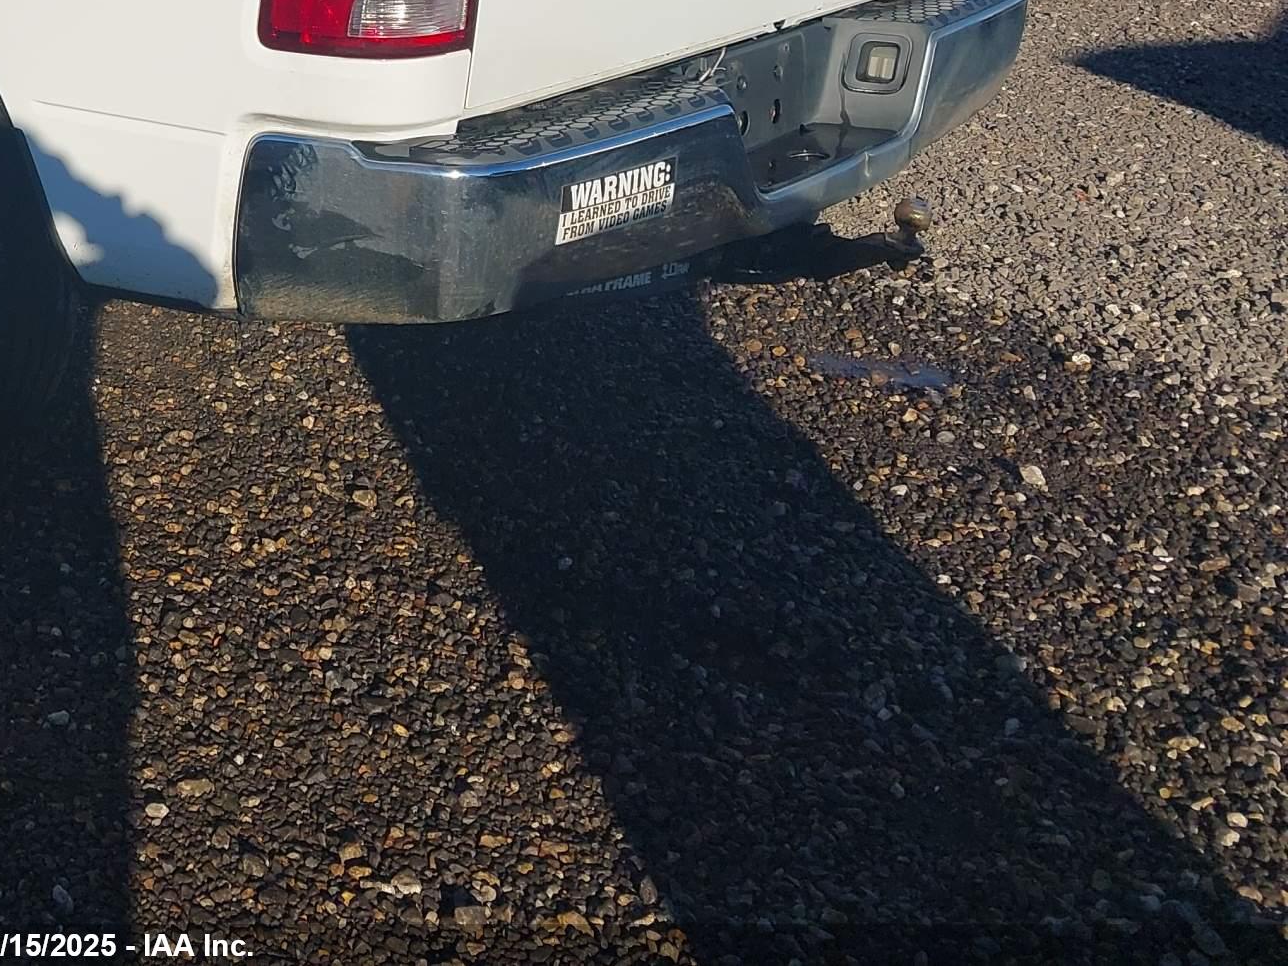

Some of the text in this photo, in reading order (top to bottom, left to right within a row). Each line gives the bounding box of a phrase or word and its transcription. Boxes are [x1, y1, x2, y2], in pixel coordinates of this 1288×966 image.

[562, 185, 672, 228] I LEARNED TO DRIVE
[571, 161, 671, 211] WARNING:
[562, 199, 667, 241] FROM VIDEO GAMES
